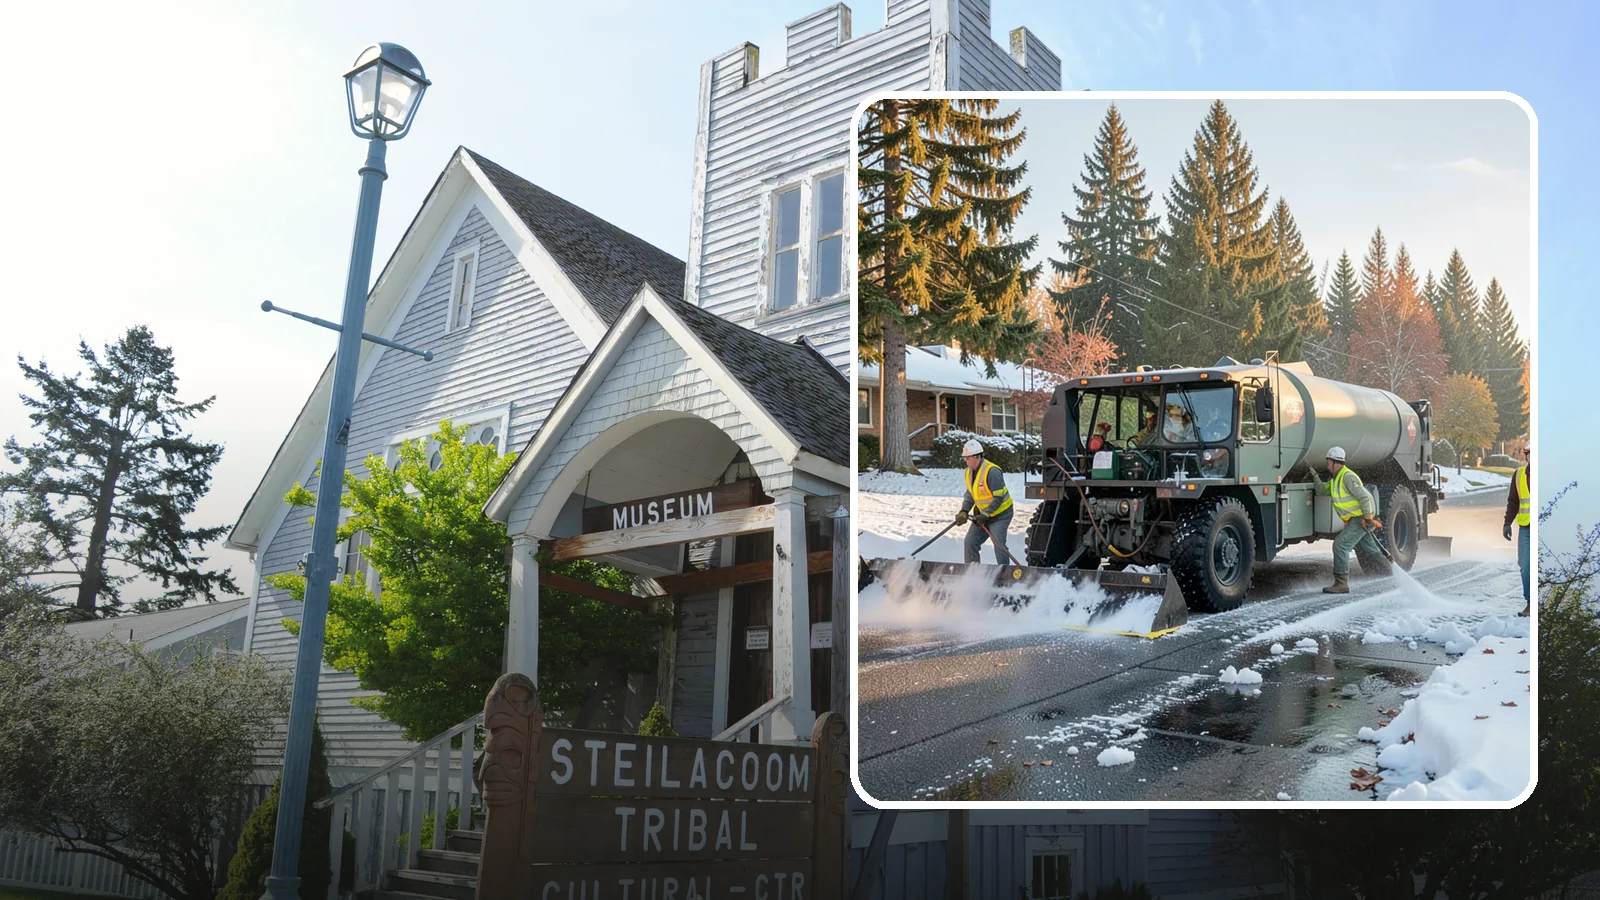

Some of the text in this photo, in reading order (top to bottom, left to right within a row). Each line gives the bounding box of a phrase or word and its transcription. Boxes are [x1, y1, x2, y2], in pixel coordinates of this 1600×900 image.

[613, 492, 713, 531] MUSEUM
[550, 738, 809, 792] STEILACOOM
[615, 807, 757, 851] TRIBAL
